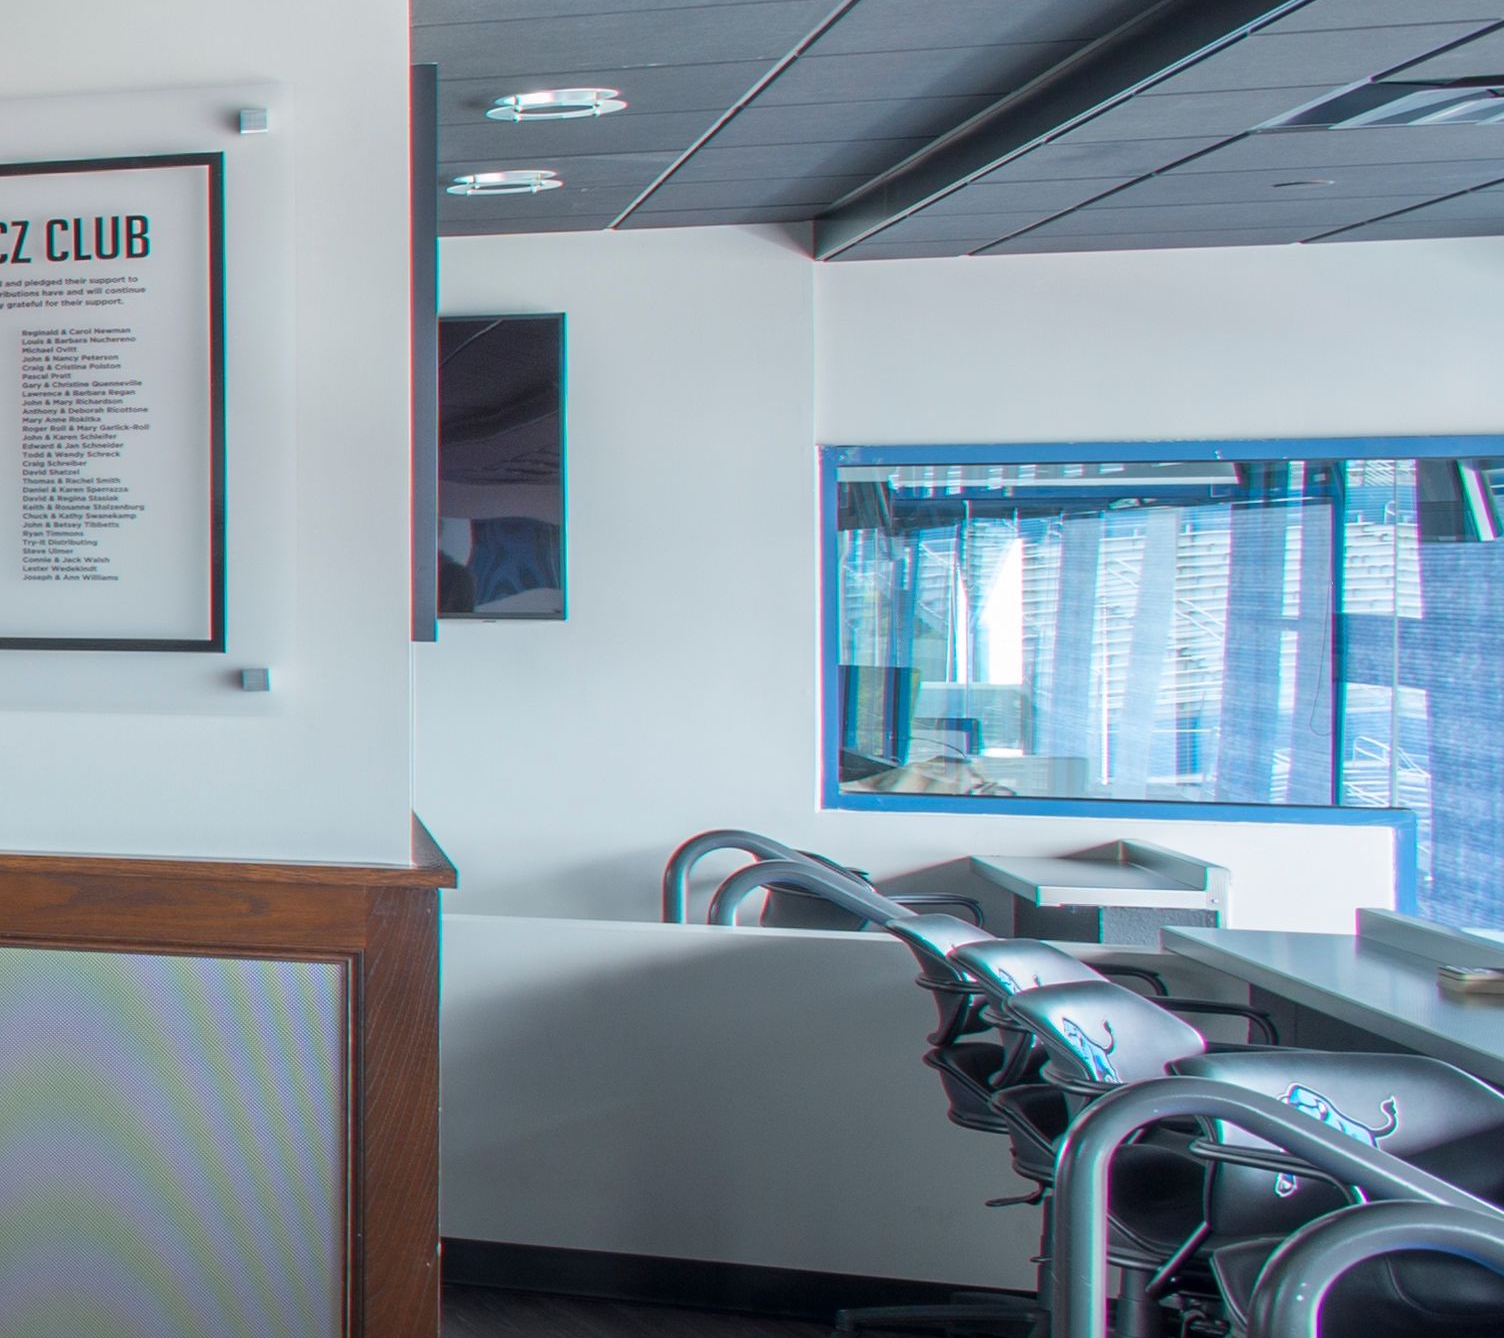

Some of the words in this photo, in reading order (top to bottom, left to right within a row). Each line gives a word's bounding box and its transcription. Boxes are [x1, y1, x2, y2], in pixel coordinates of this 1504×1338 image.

[46, 214, 152, 263] CLUB
[4, 280, 22, 288] and
[23, 279, 63, 289] pledged
[64, 278, 86, 286] their
[88, 277, 125, 287] support
[41, 289, 64, 297] have
[66, 288, 84, 296] and
[85, 288, 102, 296] will
[104, 286, 146, 295] continue
[6, 300, 43, 311] grateful
[44, 300, 59, 308] for
[60, 299, 83, 307] their
[84, 298, 122, 308] support.
